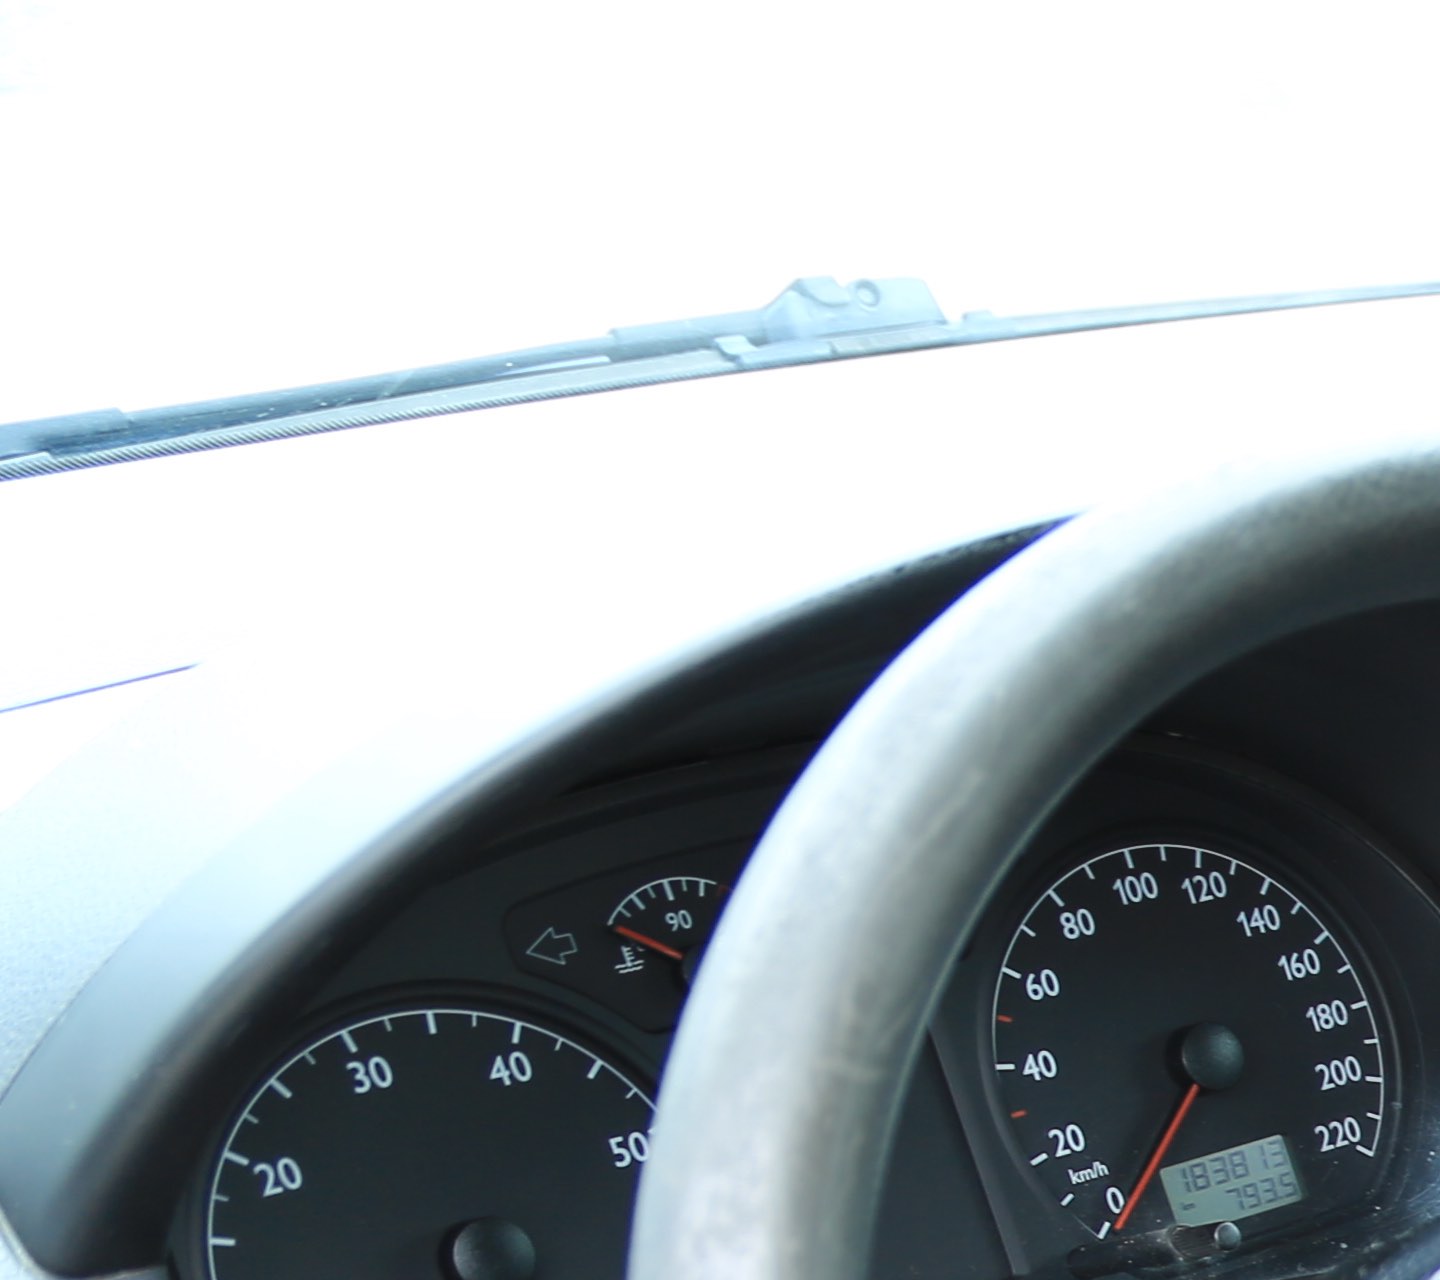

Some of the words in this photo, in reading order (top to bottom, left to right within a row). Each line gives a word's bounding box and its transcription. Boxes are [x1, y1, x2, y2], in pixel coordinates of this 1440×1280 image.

[1113, 872, 1159, 905] 100
[1181, 871, 1227, 904] 120
[665, 909, 693, 931] 90
[1059, 908, 1095, 940] 80
[1237, 904, 1281, 937] 140
[1278, 948, 1321, 981] 160
[1026, 969, 1060, 1000] 60
[1306, 1000, 1349, 1032] 180
[346, 1055, 393, 1094] 30
[489, 1051, 533, 1087] 40
[1022, 1050, 1057, 1081] 40
[1315, 1055, 1362, 1091] 200
[608, 1131, 650, 1168] 50
[1048, 1124, 1086, 1158] 20
[1314, 1116, 1362, 1152] 220
[253, 1157, 303, 1197] 20
[1068, 1161, 1109, 1186] km/h
[1106, 1187, 1125, 1213] 0
